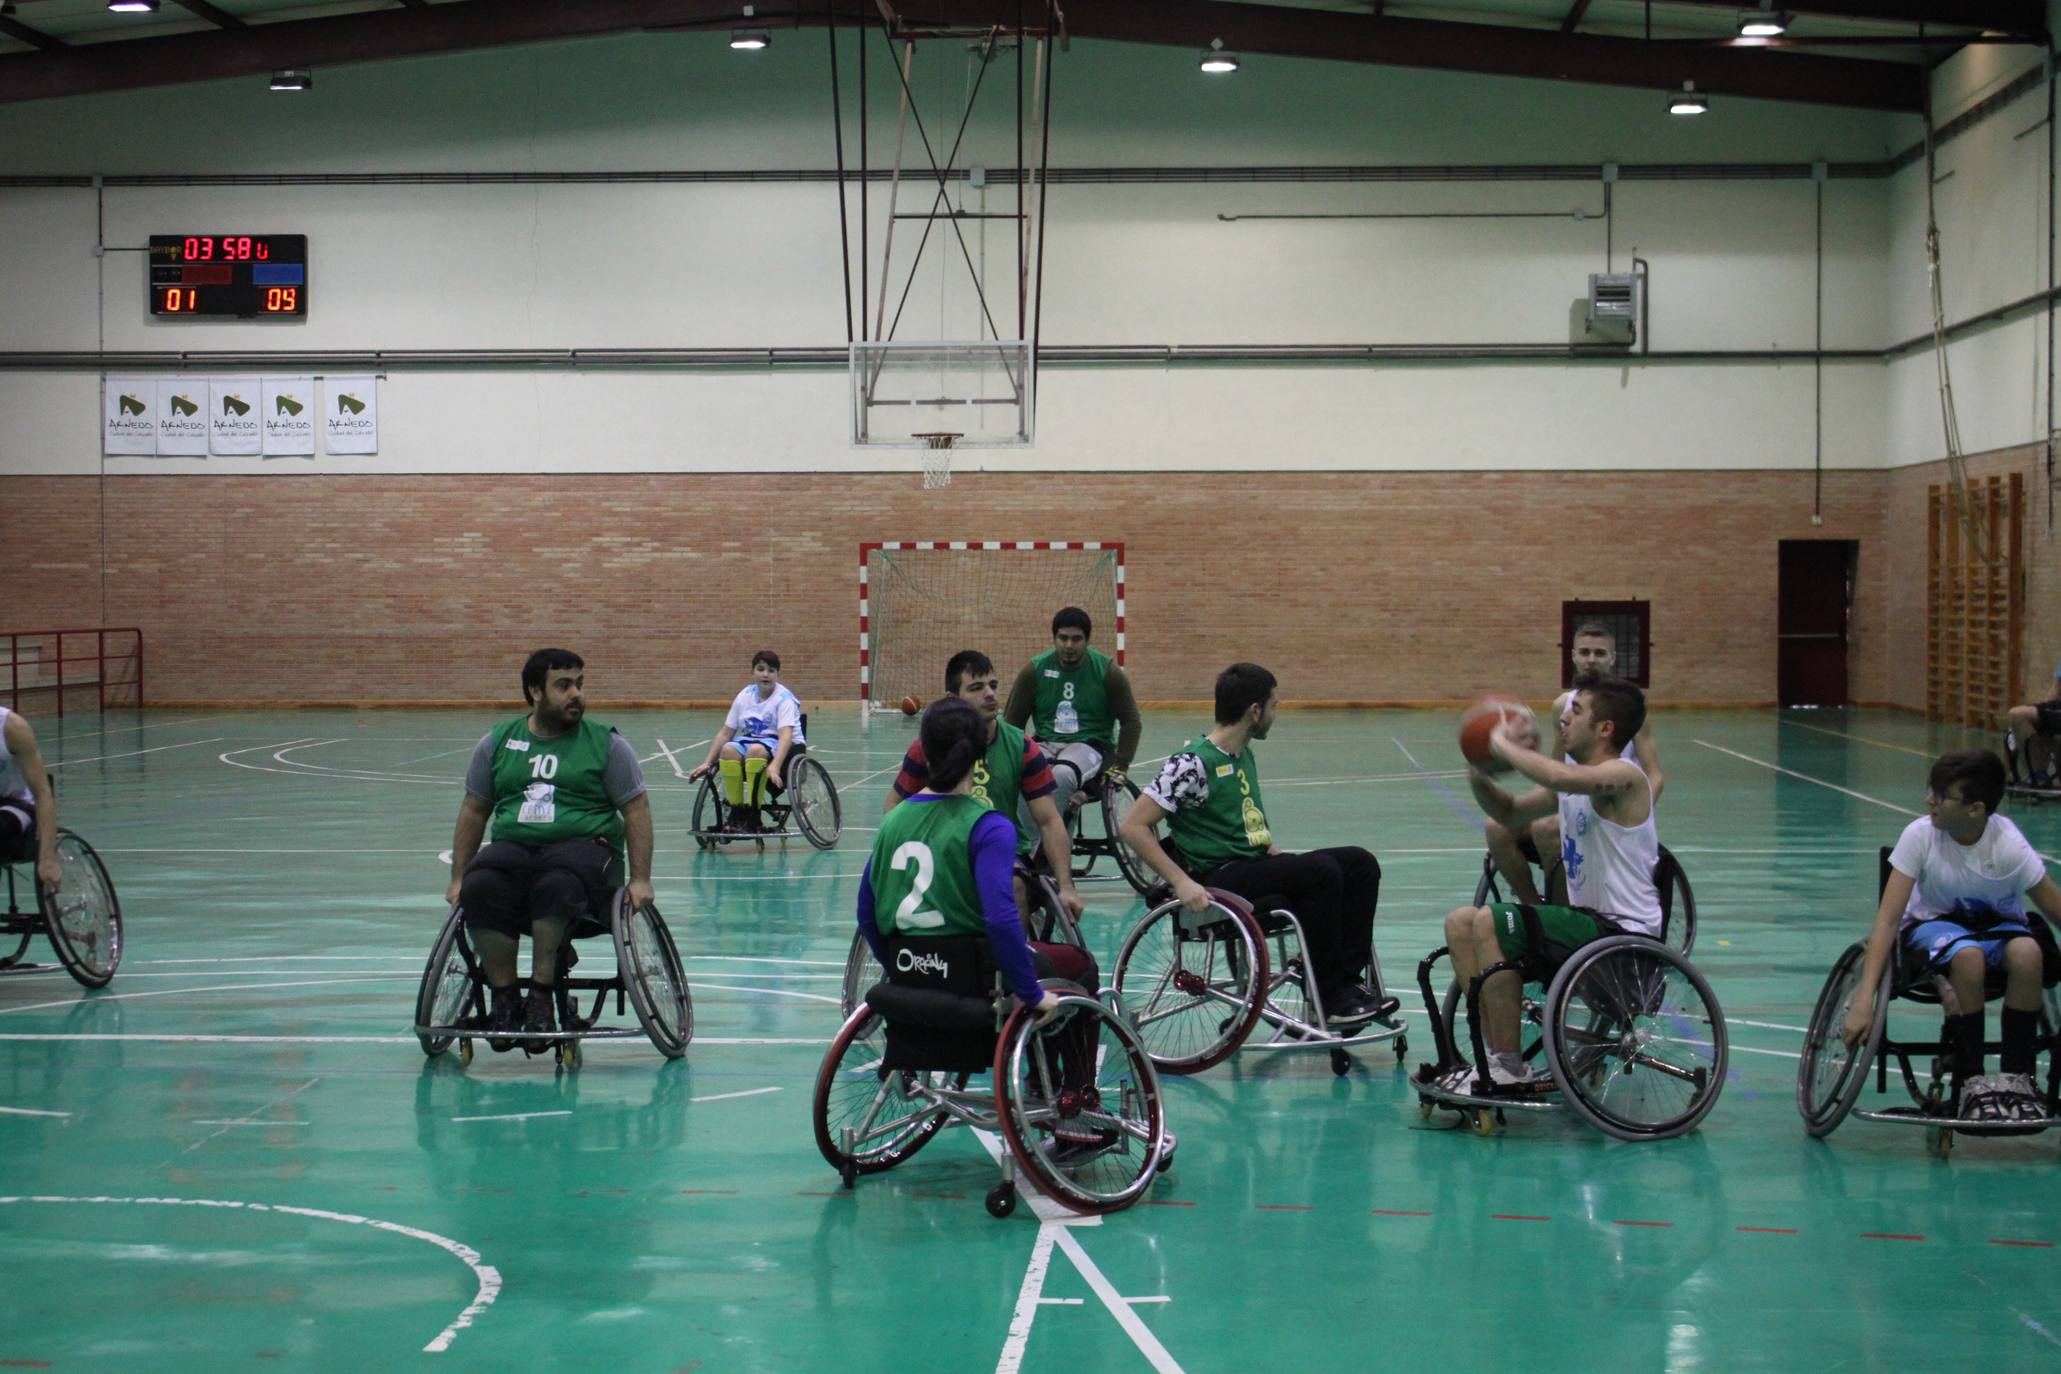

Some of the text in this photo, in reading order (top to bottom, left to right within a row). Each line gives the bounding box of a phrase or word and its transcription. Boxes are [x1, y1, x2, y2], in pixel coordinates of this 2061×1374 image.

[184, 237, 214, 260] 03
[222, 237, 251, 260] 58
[166, 288, 196, 311] 01
[328, 417, 374, 431] ARNEDO
[1062, 681, 1075, 700] 8
[528, 753, 558, 779] 10
[973, 759, 990, 785] 5
[1237, 768, 1250, 796] 3
[890, 840, 946, 930] 2
